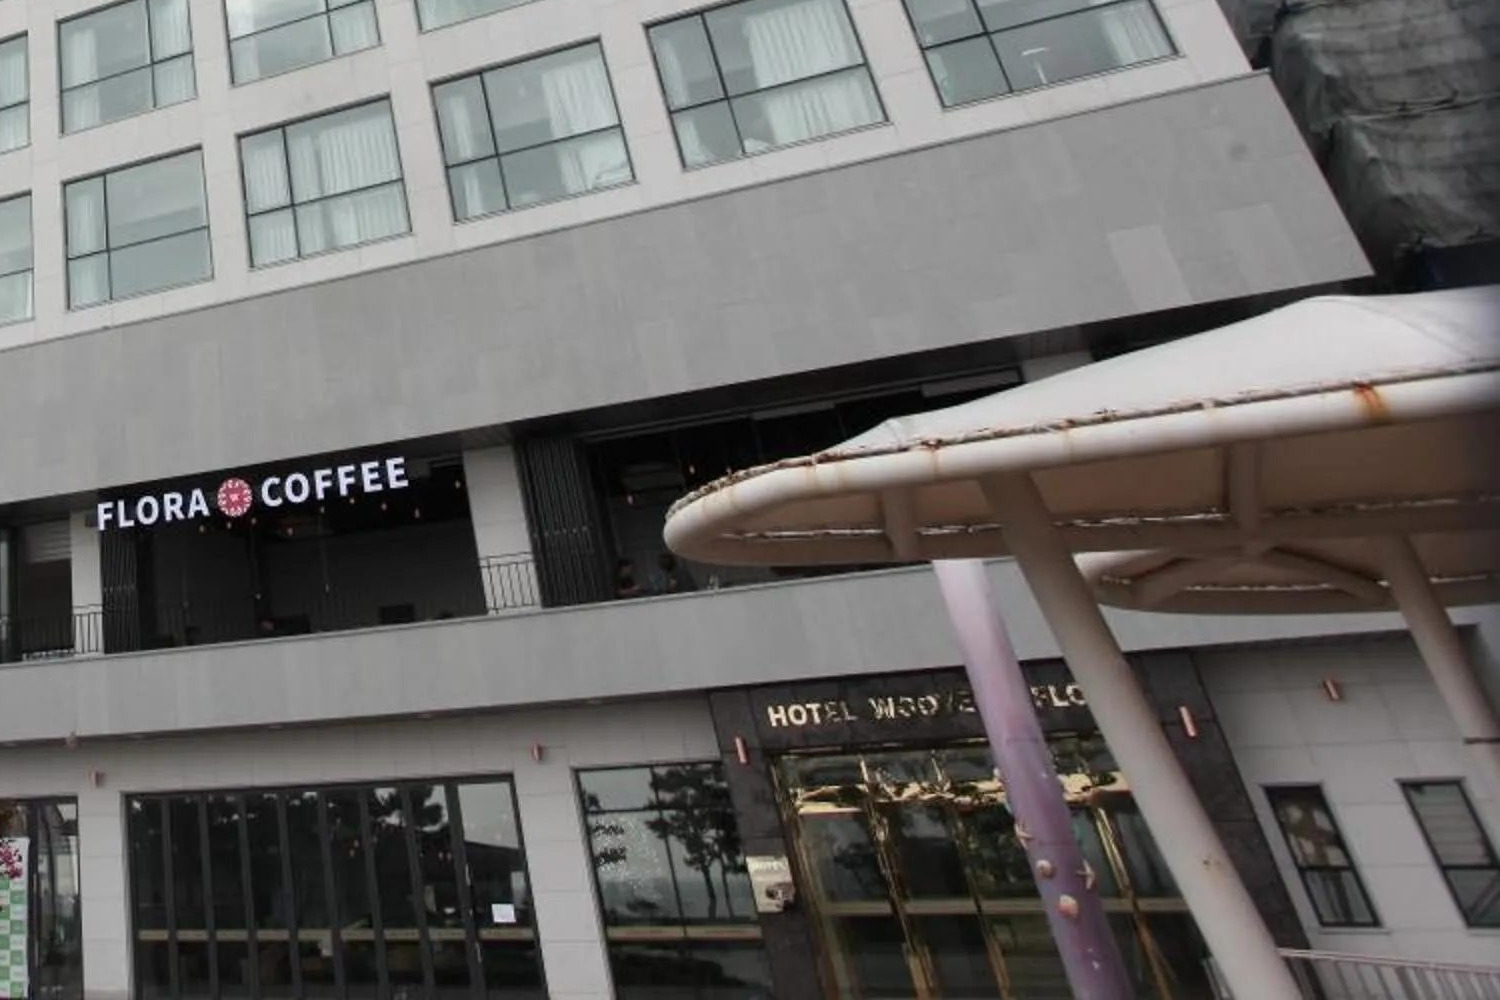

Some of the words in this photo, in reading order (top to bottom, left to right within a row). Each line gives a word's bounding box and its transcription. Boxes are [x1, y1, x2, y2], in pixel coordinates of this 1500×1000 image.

[97, 488, 210, 531] FLORA
[261, 457, 409, 508] COFFEE
[767, 701, 858, 728] HOTEL
